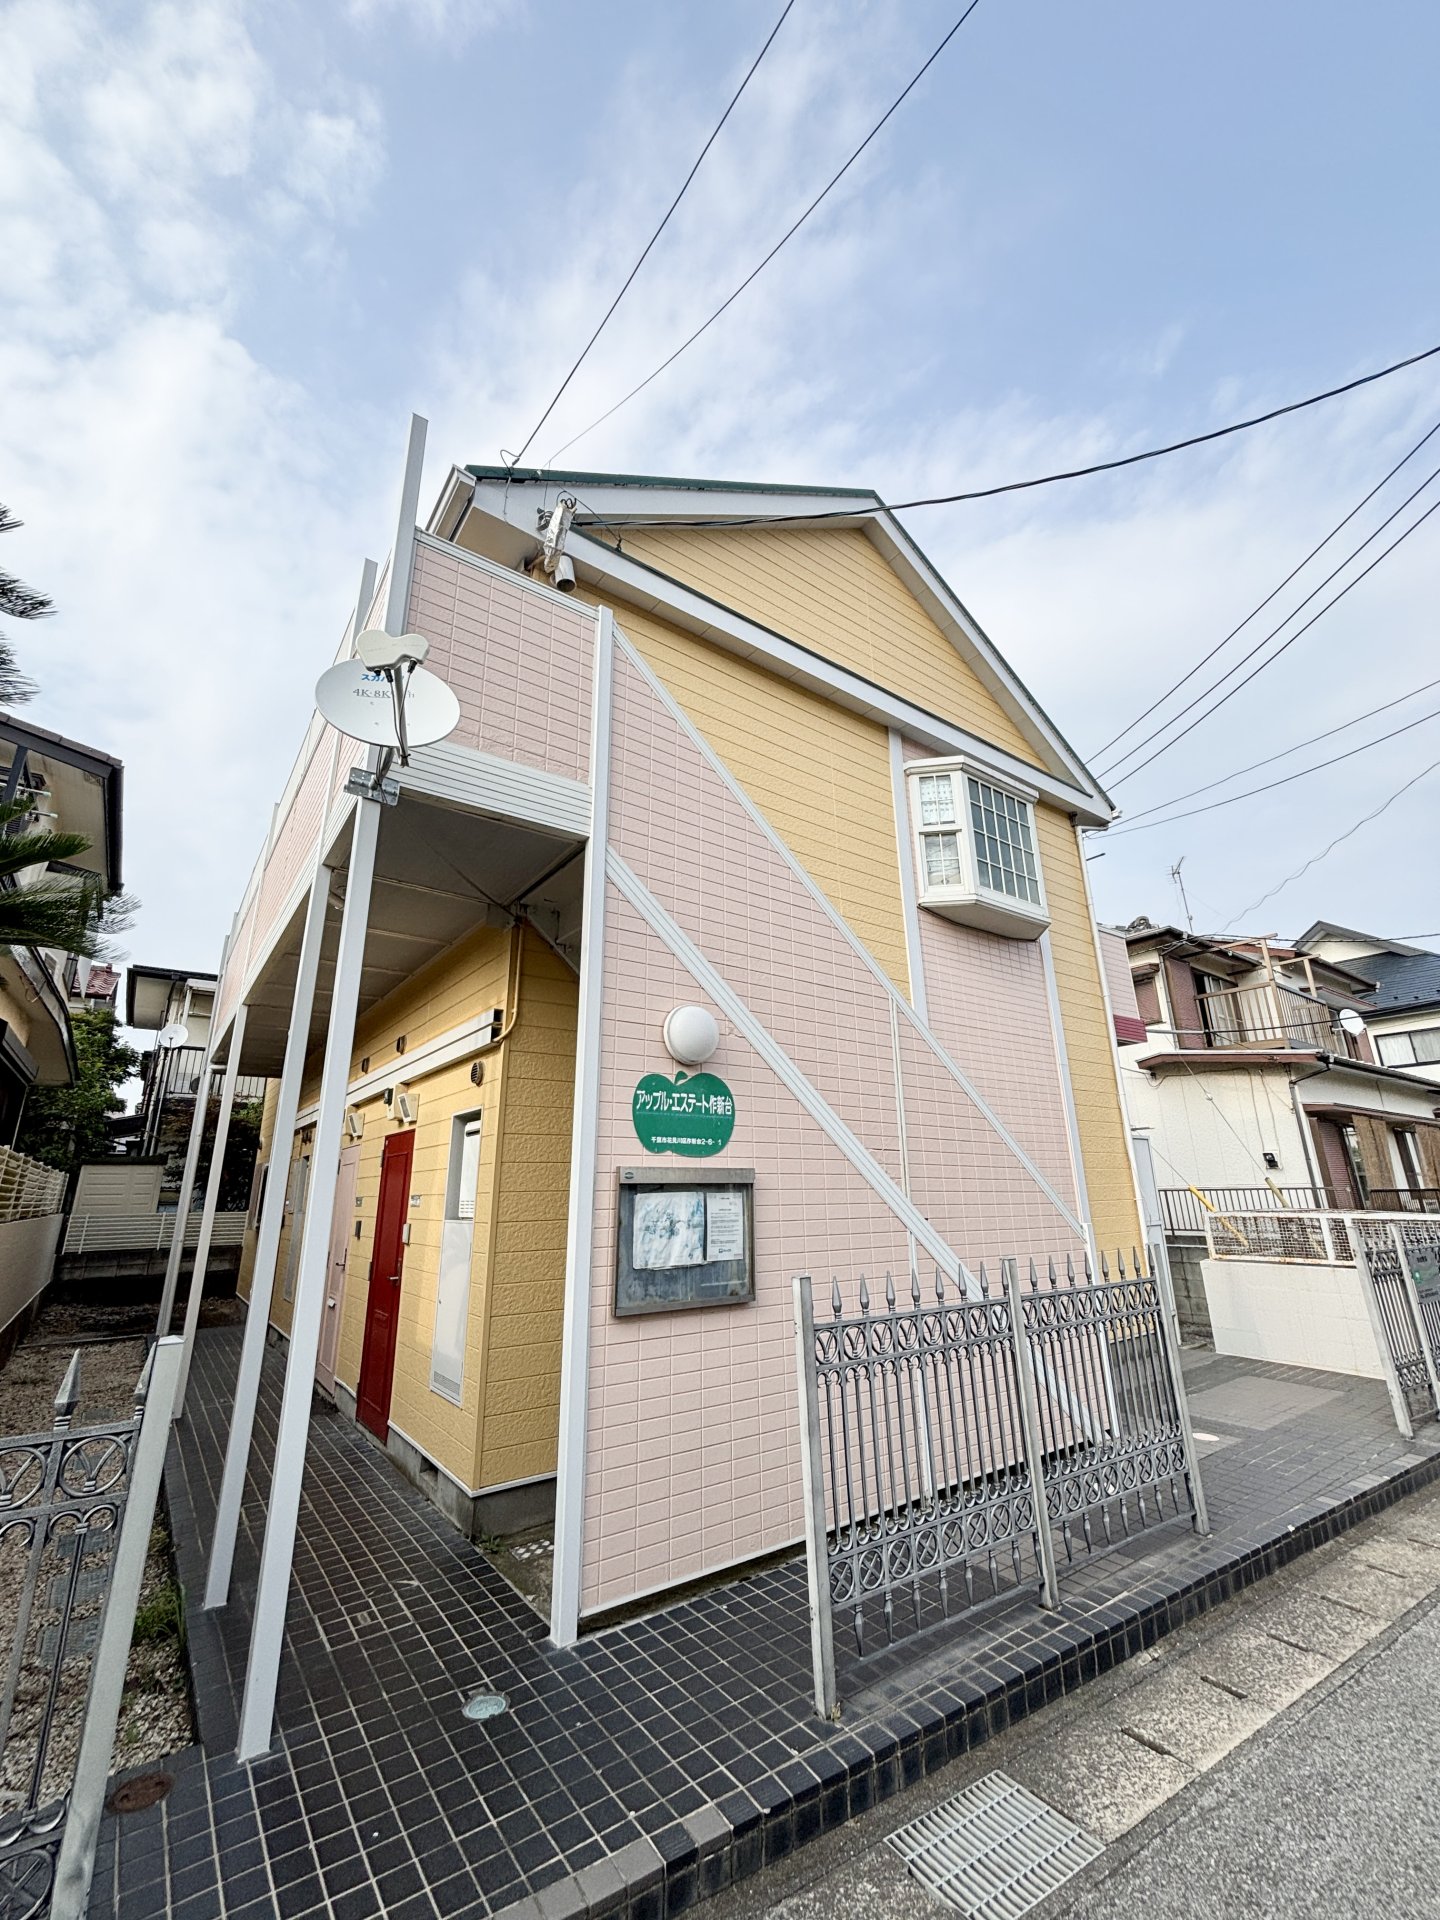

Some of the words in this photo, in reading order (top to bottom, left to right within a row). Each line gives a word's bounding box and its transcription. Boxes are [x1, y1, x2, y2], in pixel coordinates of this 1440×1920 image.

[636, 1090, 733, 1115] アップル・エステート作新台
